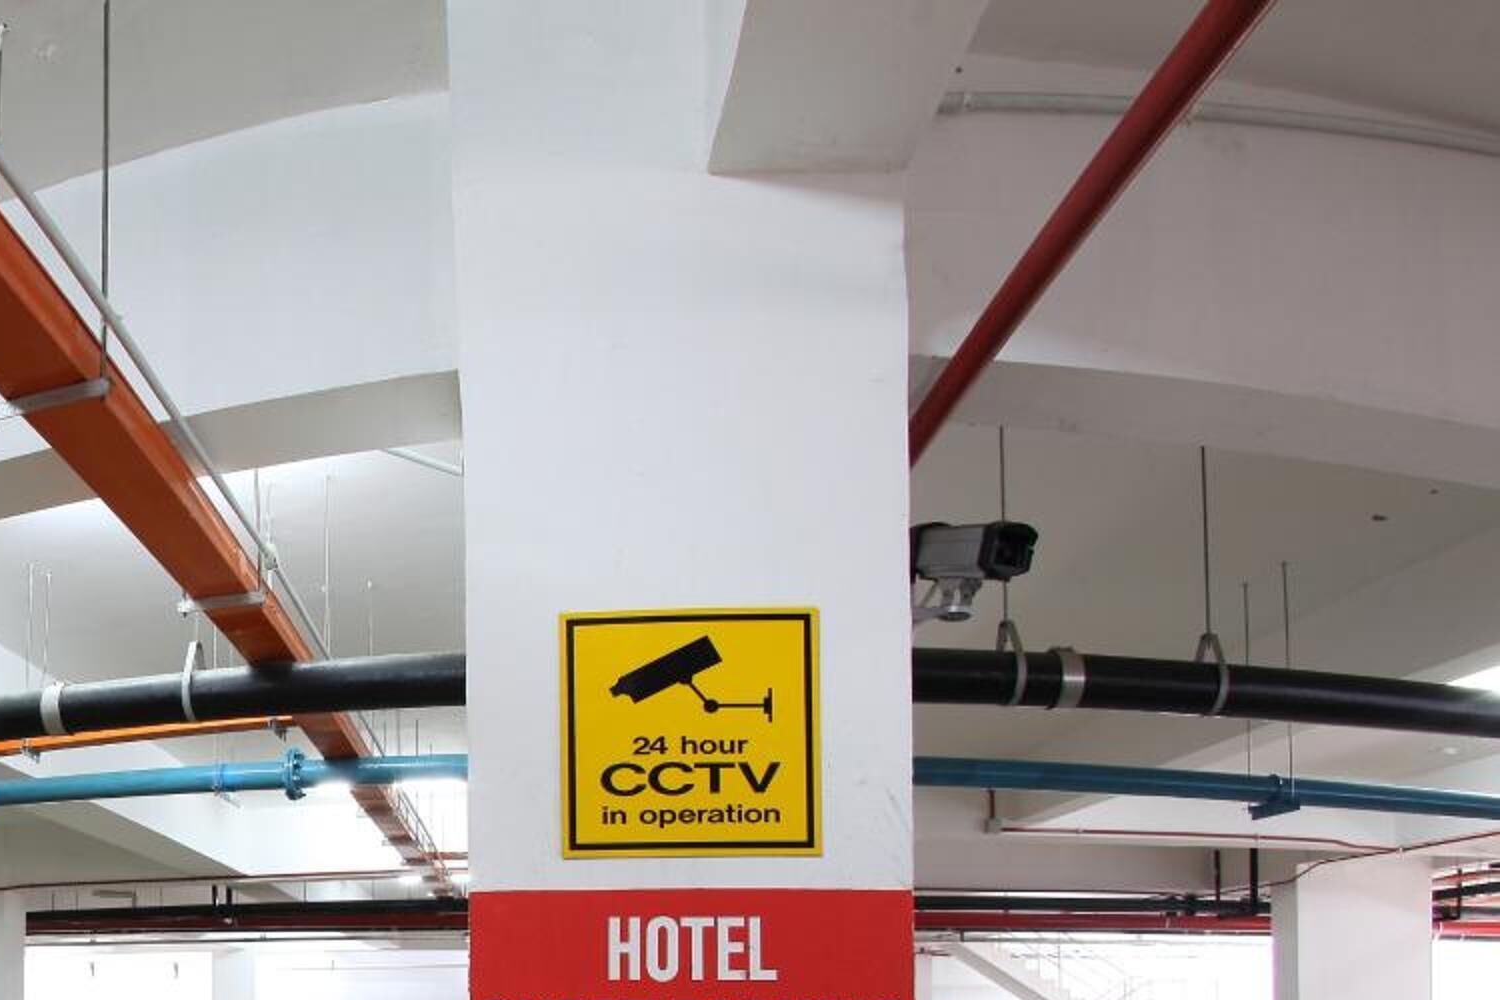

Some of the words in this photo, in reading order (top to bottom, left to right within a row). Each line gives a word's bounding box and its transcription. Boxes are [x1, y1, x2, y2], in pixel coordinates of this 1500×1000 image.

[632, 736, 668, 755] 24
[680, 735, 748, 755] hour
[599, 761, 781, 797] CCTV
[602, 805, 627, 825] in
[638, 803, 781, 829] operation
[607, 915, 778, 983] HOTEL
